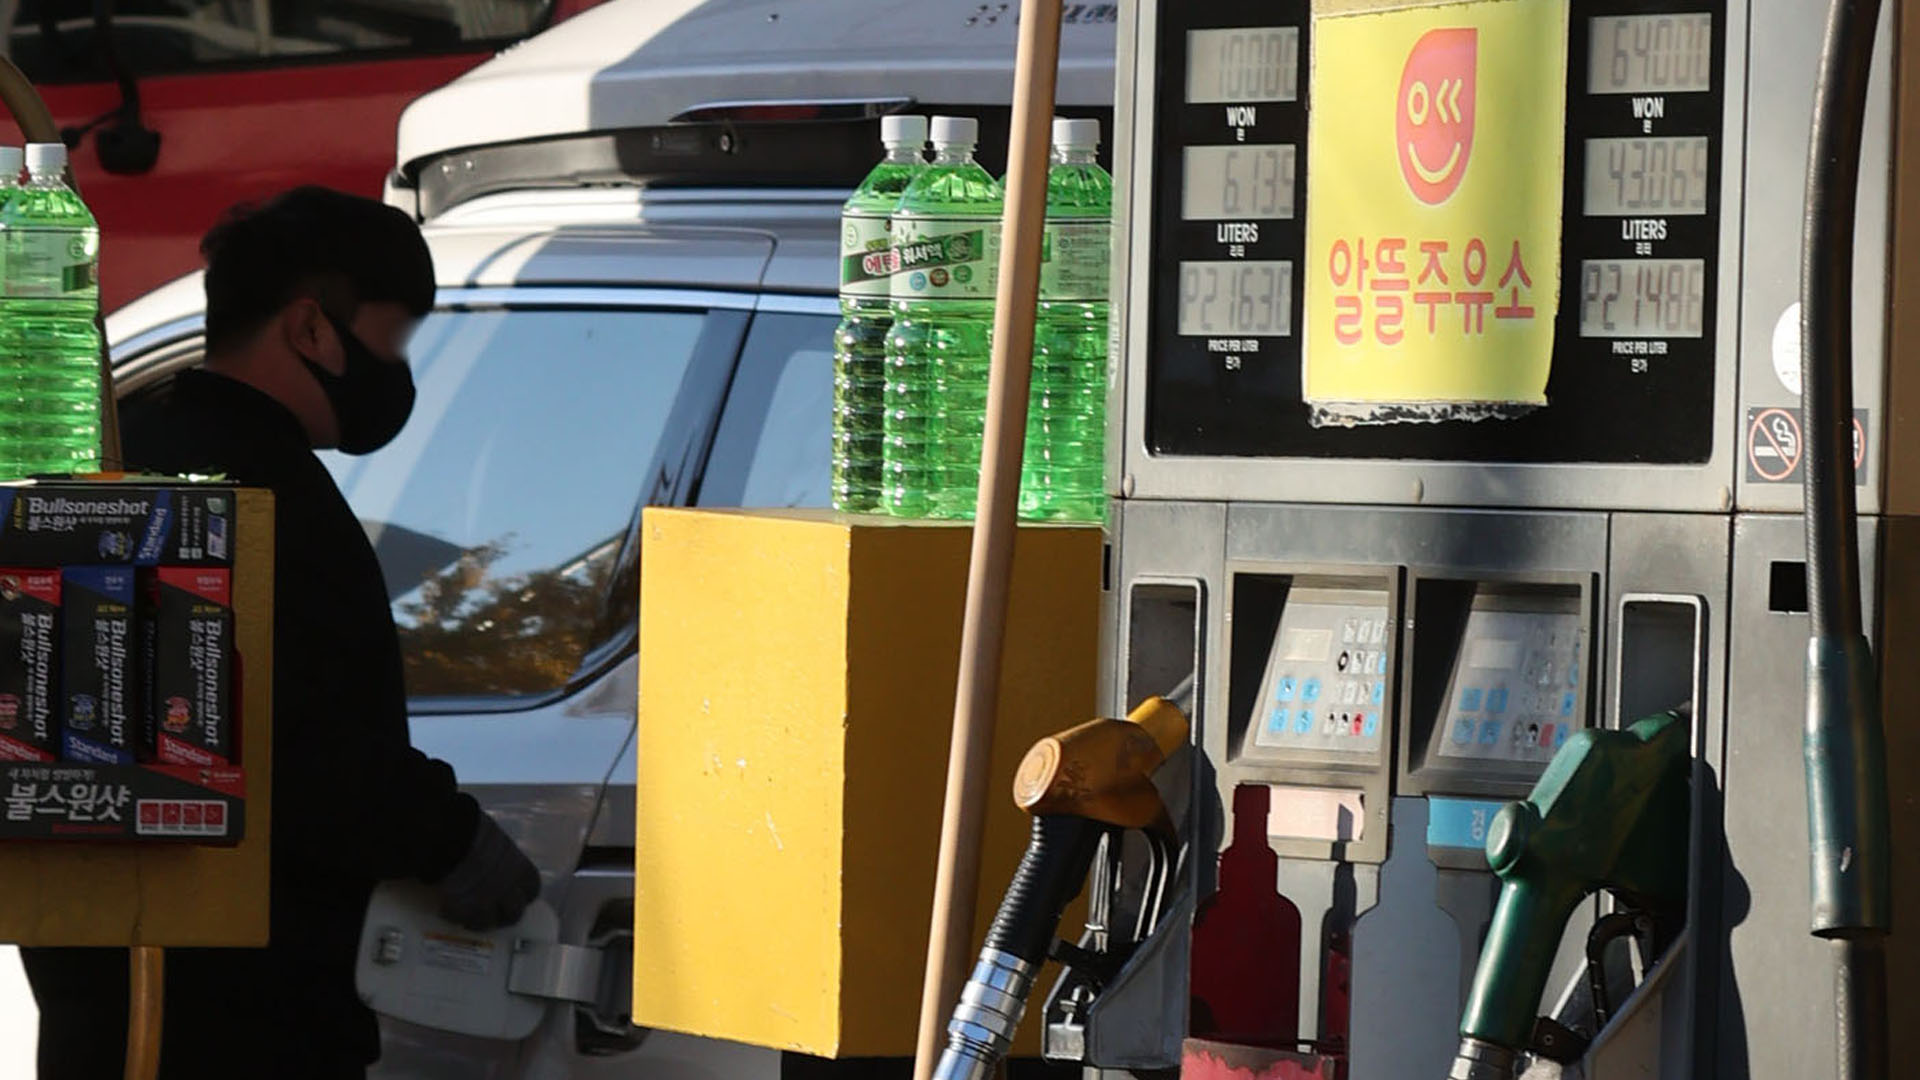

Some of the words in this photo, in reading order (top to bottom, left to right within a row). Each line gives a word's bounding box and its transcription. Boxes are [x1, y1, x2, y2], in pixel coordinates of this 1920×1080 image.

[1226, 106, 1256, 126] WON
[1632, 97, 1664, 118] WON
[1217, 223, 1258, 243] LITERS
[1622, 219, 1667, 240] LITERS
[1229, 245, 1245, 257] 리터
[1635, 242, 1652, 255] 리터
[1329, 237, 1535, 345] 알뜰주유소
[1208, 339, 1228, 352] PRICE
[1228, 339, 1241, 352] PER
[1241, 340, 1259, 352] LITER
[1612, 341, 1634, 354] PRICE
[1634, 341, 1648, 354] PER
[1648, 341, 1668, 354] LITER
[1225, 356, 1241, 369] 단가
[1631, 358, 1648, 373] 단가
[28, 496, 150, 515] Bullsoneshot
[28, 514, 77, 532] 불스원샷
[21, 613, 36, 664] 불스원샷
[95, 620, 111, 670] 불스원샷
[190, 620, 206, 671] 불스원샷
[34, 613, 53, 738] Bullsoneshot
[110, 619, 127, 746] Bullsoneshot
[205, 619, 222, 746] Bullsoneshot
[68, 736, 118, 764] Standard
[164, 738, 212, 766] Standard
[5, 783, 131, 821] 불스원샷
